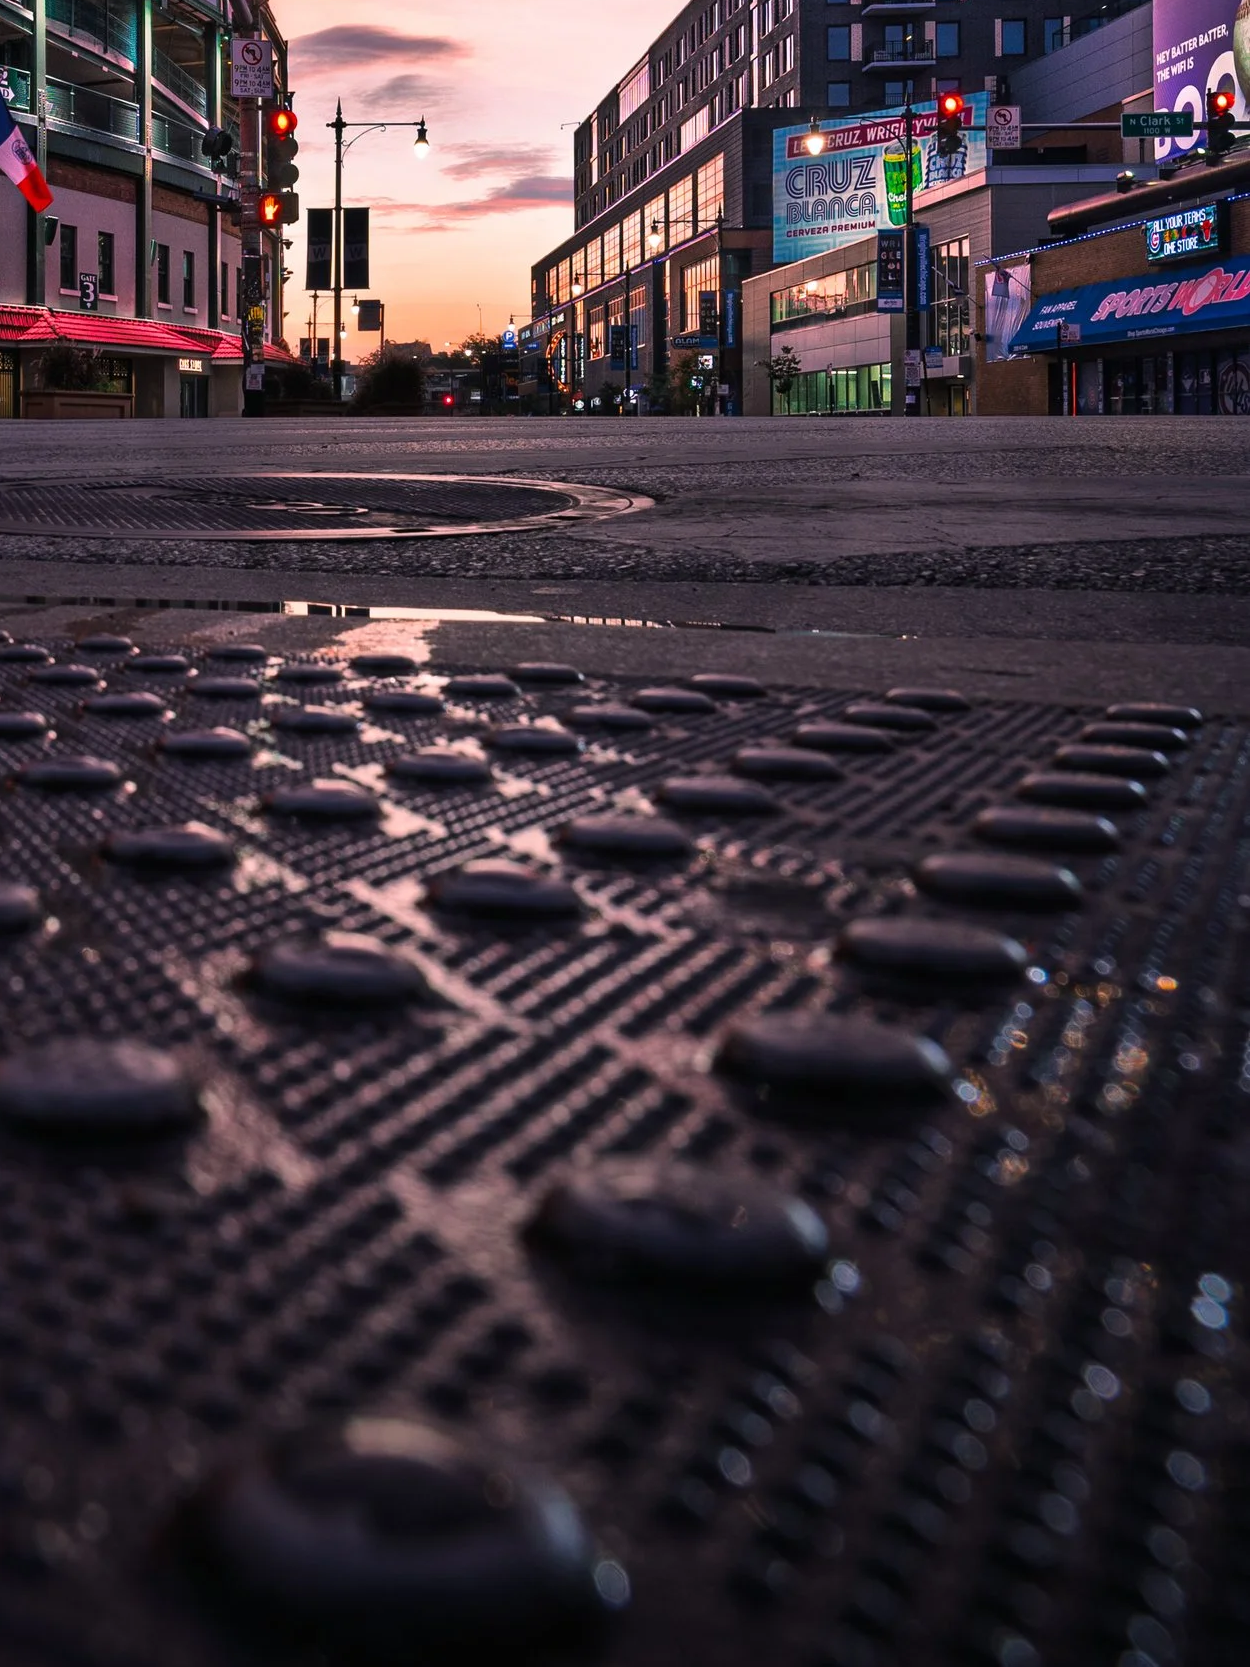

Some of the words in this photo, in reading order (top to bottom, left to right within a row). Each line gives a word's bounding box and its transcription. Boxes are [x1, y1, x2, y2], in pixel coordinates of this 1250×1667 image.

[1156, 48, 1170, 66] HEY
[1171, 36, 1198, 59] BATTER
[1199, 23, 1229, 50] BATTER,
[1156, 66, 1170, 83] THE
[1170, 60, 1186, 78] WIFI
[1187, 56, 1195, 71] IS
[1140, 115, 1171, 126] Clark
[827, 130, 862, 148] CRUZ,
[785, 155, 876, 199] CRUZ
[786, 226, 830, 238] CERVEZA
[831, 220, 876, 233] PREMIUM
[1153, 219, 1165, 233] ALL
[1165, 214, 1183, 231] YOUR
[1184, 208, 1206, 226] TEAMS
[1163, 240, 1177, 255] ONE
[1177, 235, 1199, 252] STORE
[80, 274, 96, 283] GATE
[83, 282, 95, 302] 3
[1090, 282, 1179, 322] SPORTS
[1039, 305, 1054, 315] FAN
